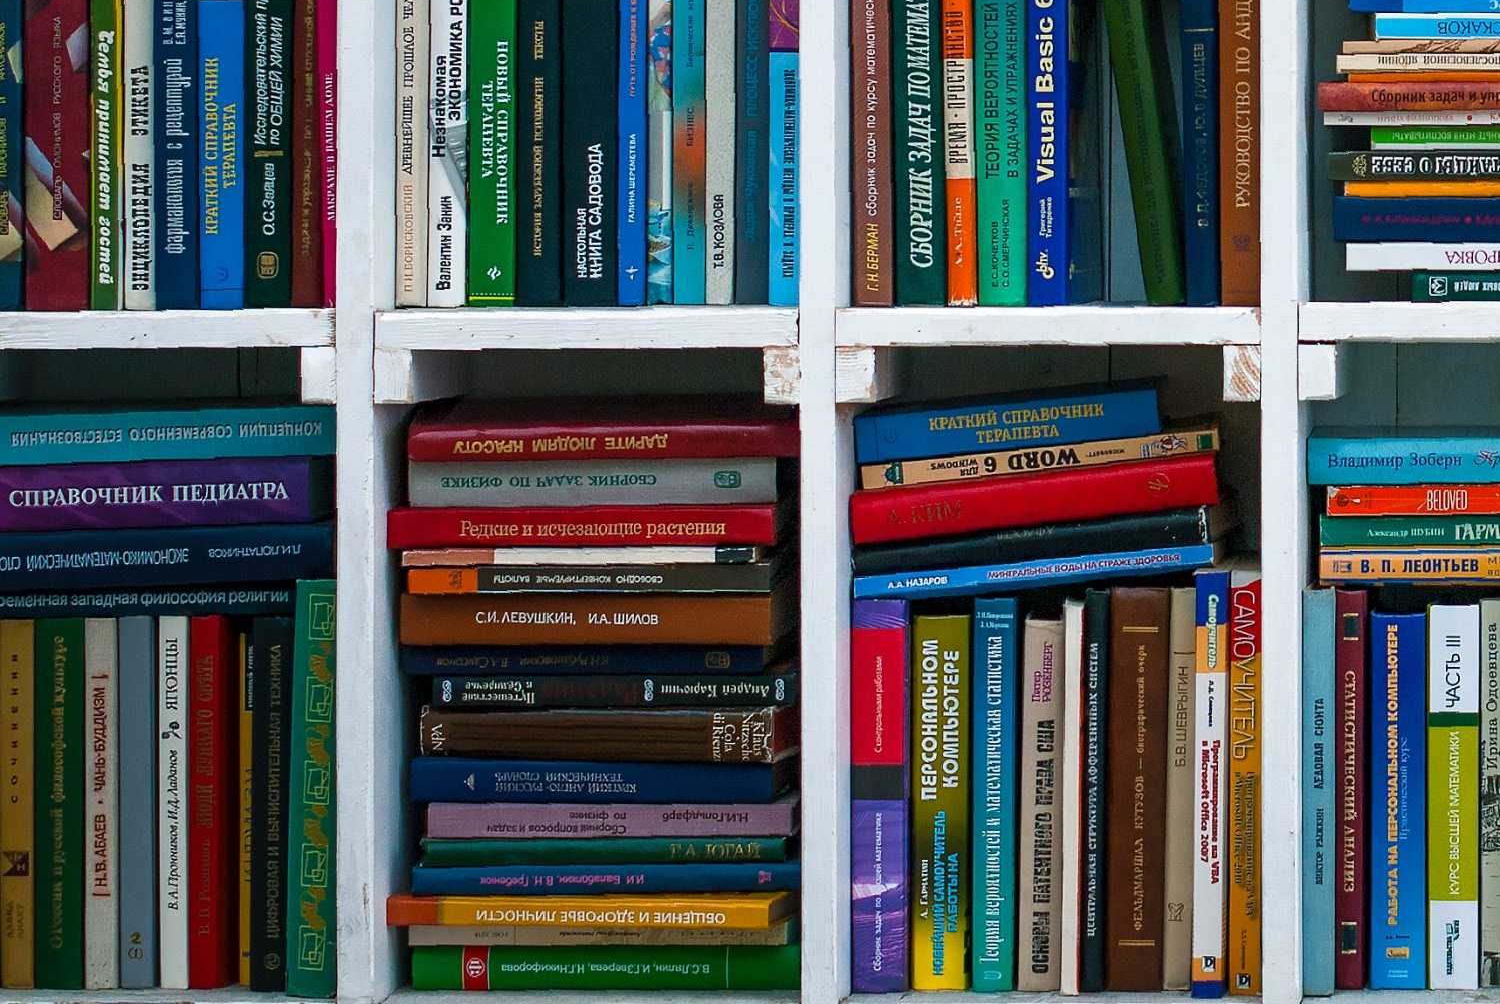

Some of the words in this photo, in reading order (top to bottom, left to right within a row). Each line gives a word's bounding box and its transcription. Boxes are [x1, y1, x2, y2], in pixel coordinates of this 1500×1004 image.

[449, 20, 464, 121] ЭКОНОМИКА
[908, 71, 931, 97] ПО
[1035, 15, 1055, 92] Basic
[1236, 47, 1251, 75] ПО
[130, 63, 150, 136] ЭТИКЕТА
[432, 55, 447, 158] Незнакомая
[909, 97, 937, 163] ЗАДАЧ
[1371, 89, 1425, 105] Сборник
[1428, 90, 1465, 104] задач
[1035, 102, 1055, 184] Visual
[1235, 81, 1251, 208] РУКОВОДСТВО
[589, 142, 603, 226] САДОВОДА
[909, 165, 934, 269] СБОРНИК
[131, 162, 151, 294] ЭНЦИКЛОПЕДИЯ
[577, 207, 587, 279] НАСТОЛЬНАЯ
[590, 229, 603, 279] КНИГА
[929, 411, 997, 431] КРАТКИЙ
[1002, 402, 1105, 425] СПРАВОЧНИК
[975, 424, 1060, 444] ТЕРАПЕВТА
[9, 486, 164, 508] СПРАВОЧНИК
[172, 482, 289, 505] ПЕДИАТРА
[1327, 453, 1404, 472] Владимир
[1410, 452, 1462, 469] Зоберн
[459, 520, 519, 538] Редкие
[537, 520, 642, 539] исчезающие
[646, 521, 726, 540] растения
[1426, 489, 1468, 511] BELOVED
[1232, 589, 1255, 761] САМОУЧИТЕЛЬ
[1445, 635, 1462, 649] III
[1445, 653, 1462, 708] ЧАСТЬ
[921, 639, 938, 801] ПЕРСОНАЛЬНОМ
[942, 649, 960, 789] КОМПЬЮТЕРЕ
